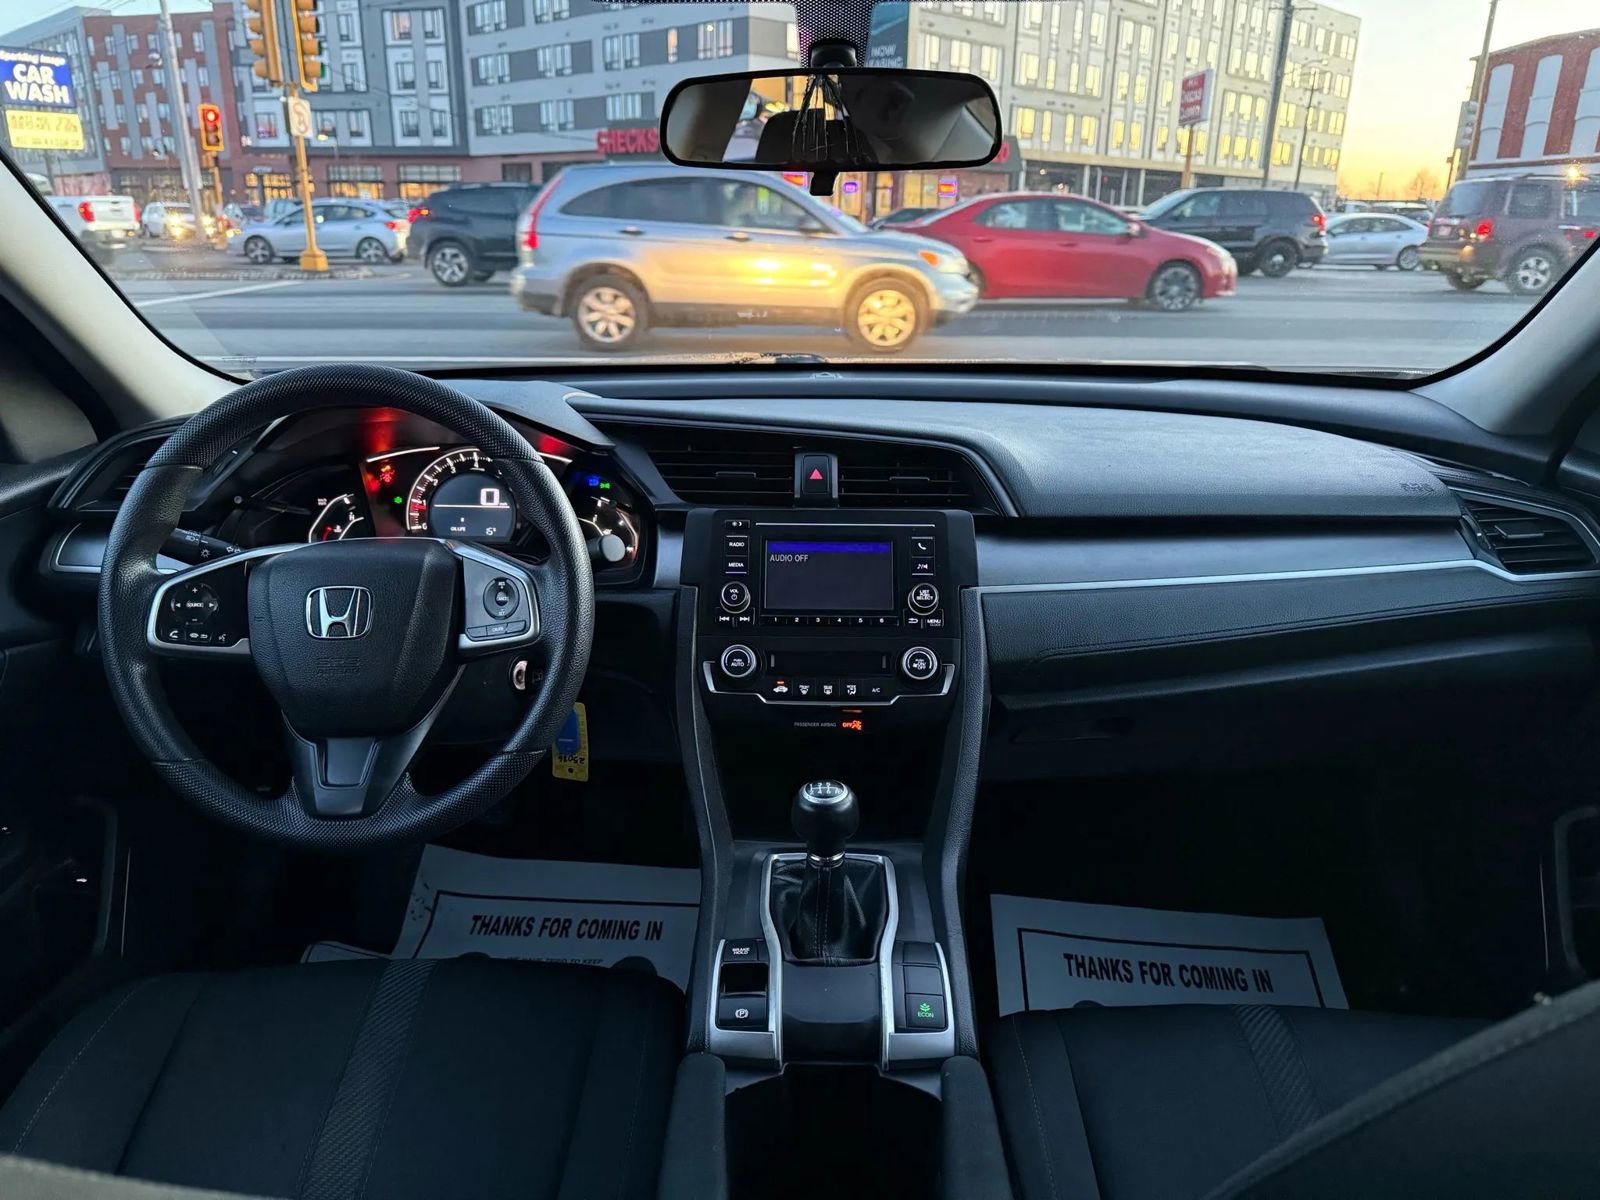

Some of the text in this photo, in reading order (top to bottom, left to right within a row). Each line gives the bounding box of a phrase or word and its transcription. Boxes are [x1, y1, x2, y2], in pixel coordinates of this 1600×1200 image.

[871, 45, 896, 57] NOW
[13, 63, 55, 84] CAR
[4, 80, 70, 103] WASH
[596, 128, 658, 155] CHECKS
[480, 488, 500, 506] 0
[769, 554, 809, 562] AUDIO OFF
[469, 915, 664, 942] THANKS FOR COMING IN
[1063, 952, 1275, 993] THANKS FOR COMING IN
